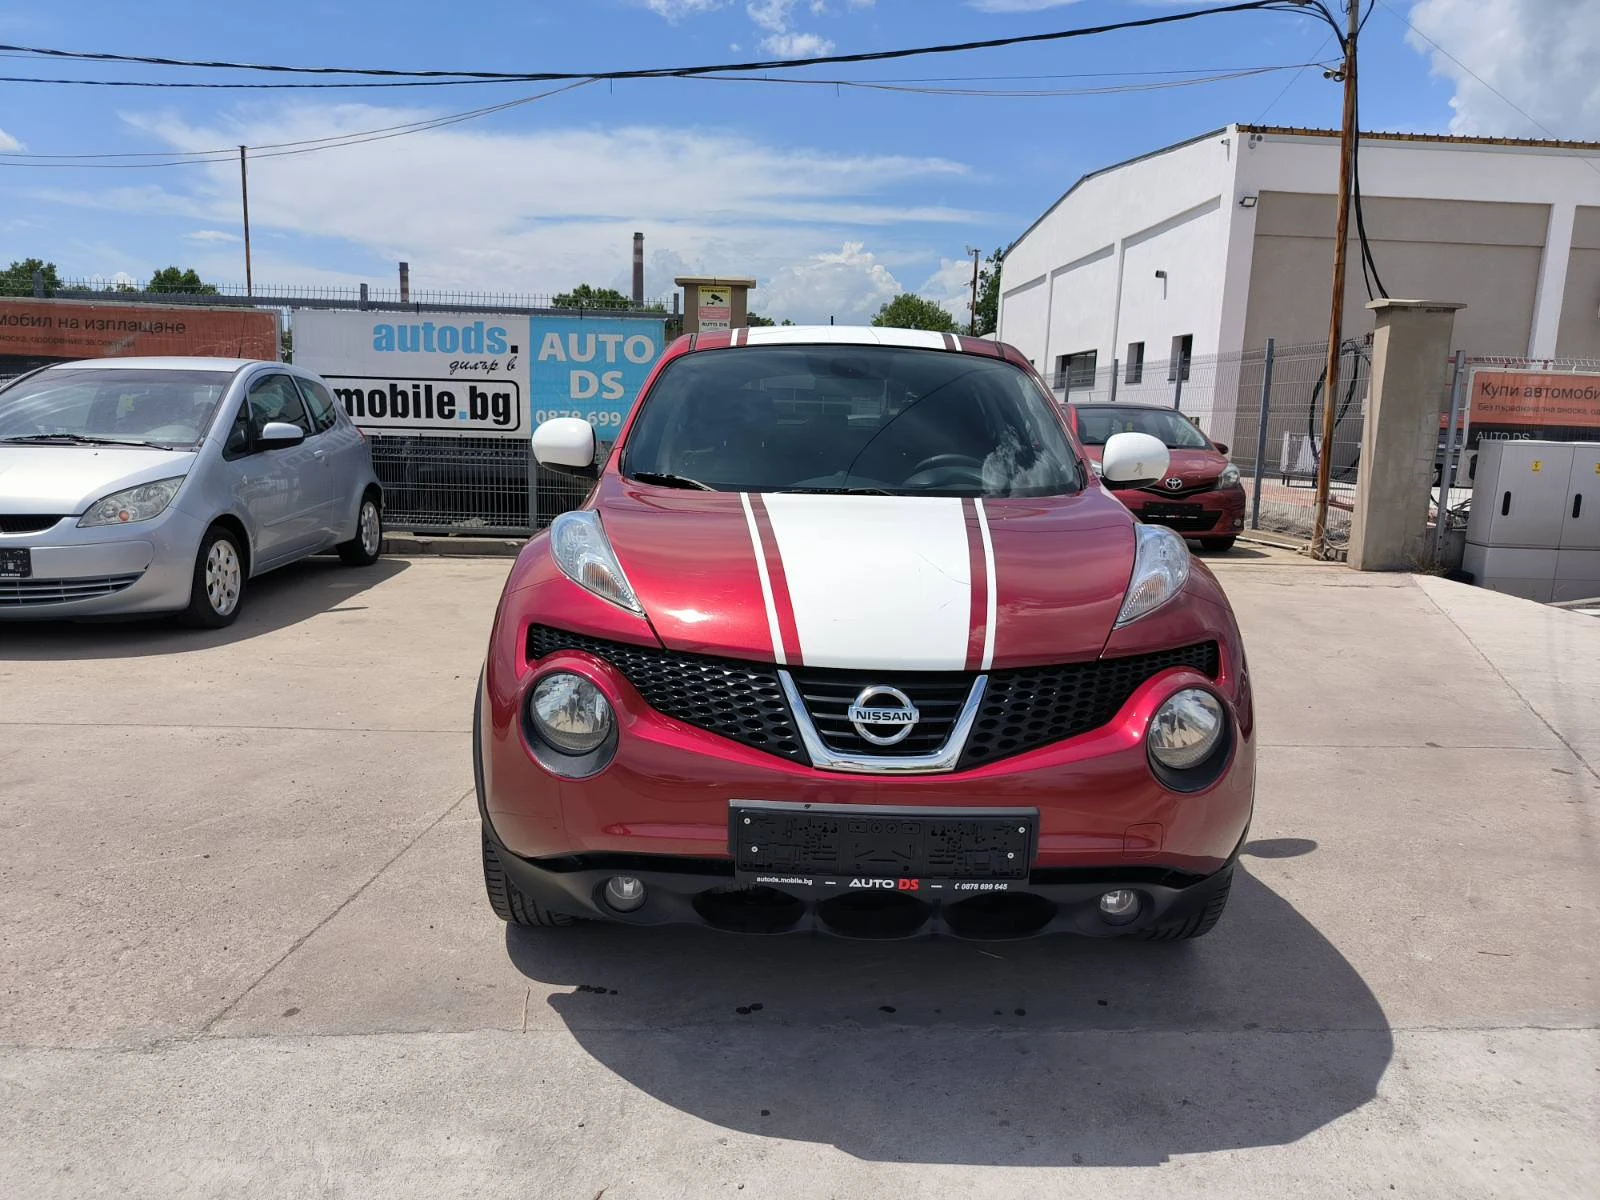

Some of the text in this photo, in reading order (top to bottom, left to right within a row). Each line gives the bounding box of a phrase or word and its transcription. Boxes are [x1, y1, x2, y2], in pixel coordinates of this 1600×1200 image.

[58, 317, 79, 329] на
[85, 319, 186, 334] изплащане
[538, 333, 655, 364] AUTO
[570, 370, 625, 400] DS
[1480, 382, 1519, 399] Купи
[333, 384, 512, 426] mobile.bg
[587, 411, 622, 426] 699
[1476, 432, 1530, 441] AUTO DS
[856, 711, 913, 721] NISSAN
[757, 877, 813, 886] autods.mobile.bg
[849, 878, 894, 889] AUTO
[898, 879, 919, 891] DS
[961, 882, 979, 890] 0878
